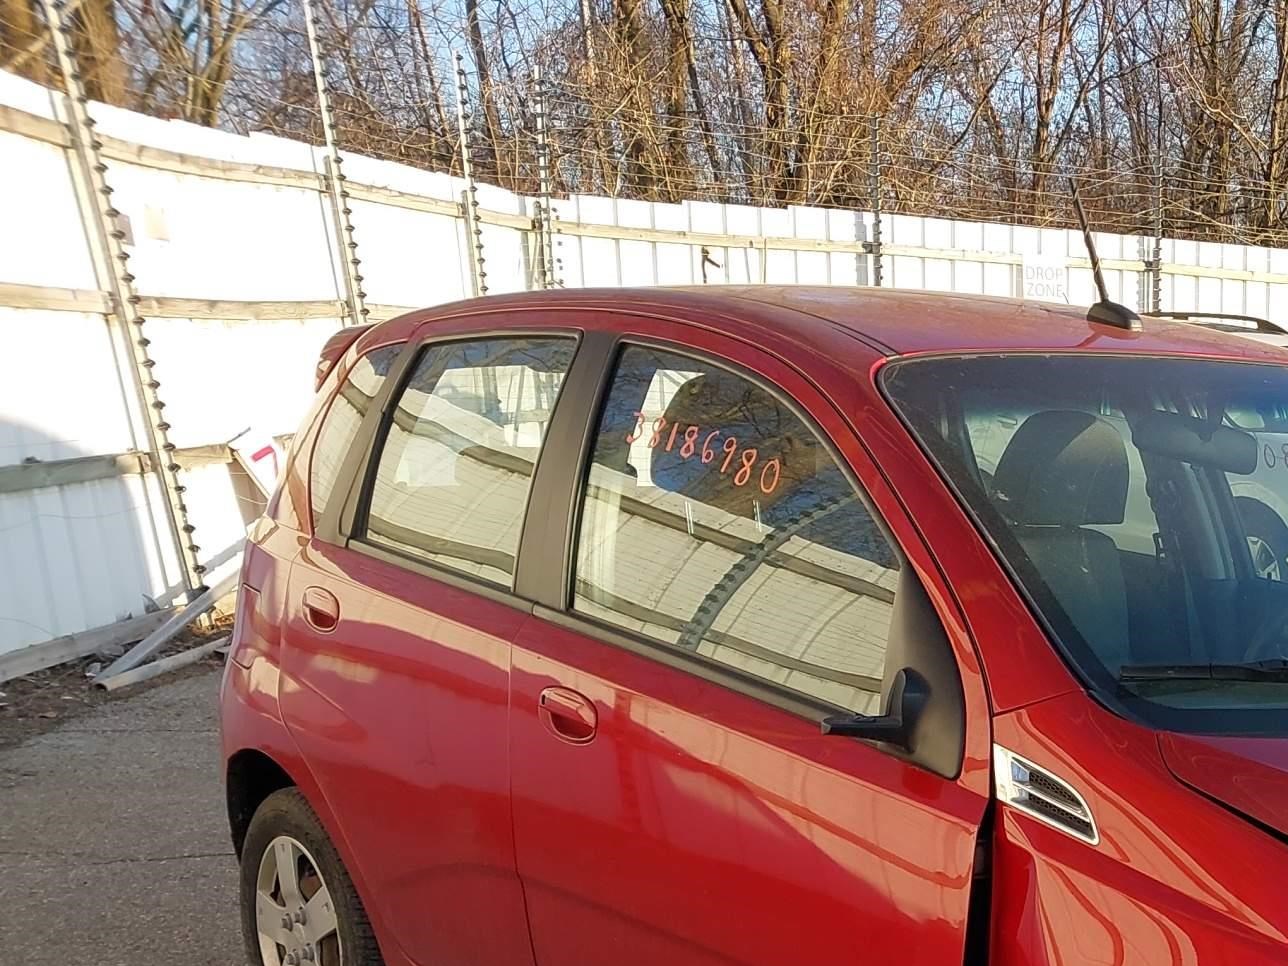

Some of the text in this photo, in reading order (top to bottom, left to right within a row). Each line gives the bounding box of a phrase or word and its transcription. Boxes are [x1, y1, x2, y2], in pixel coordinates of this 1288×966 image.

[1025, 265, 1064, 281] DROP
[1026, 282, 1065, 298] ZONE
[625, 411, 781, 495] 38186980
